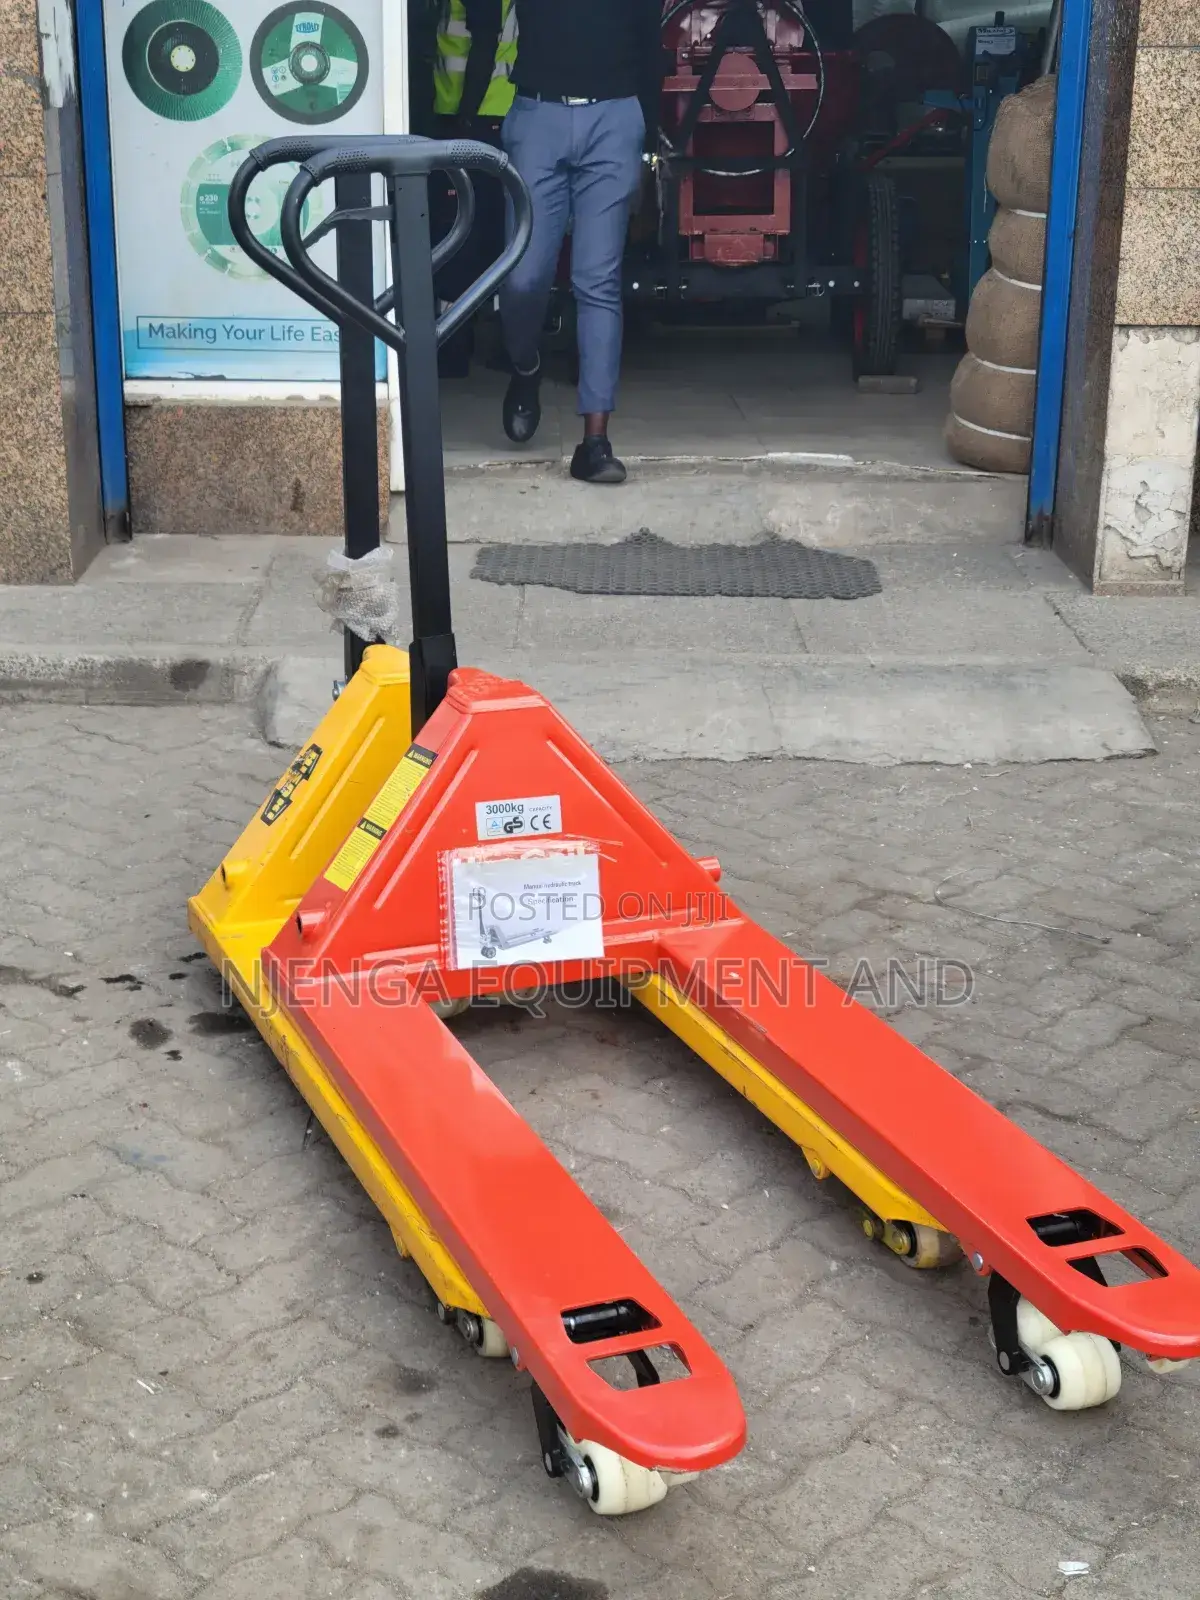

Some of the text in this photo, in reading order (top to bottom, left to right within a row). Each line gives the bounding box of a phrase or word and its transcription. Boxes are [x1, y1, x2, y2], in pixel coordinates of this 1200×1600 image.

[148, 323, 217, 344] Making
[222, 324, 266, 341] Your
[270, 325, 305, 342] Life
[485, 802, 524, 815] 3000kg
[530, 814, 552, 831] CE
